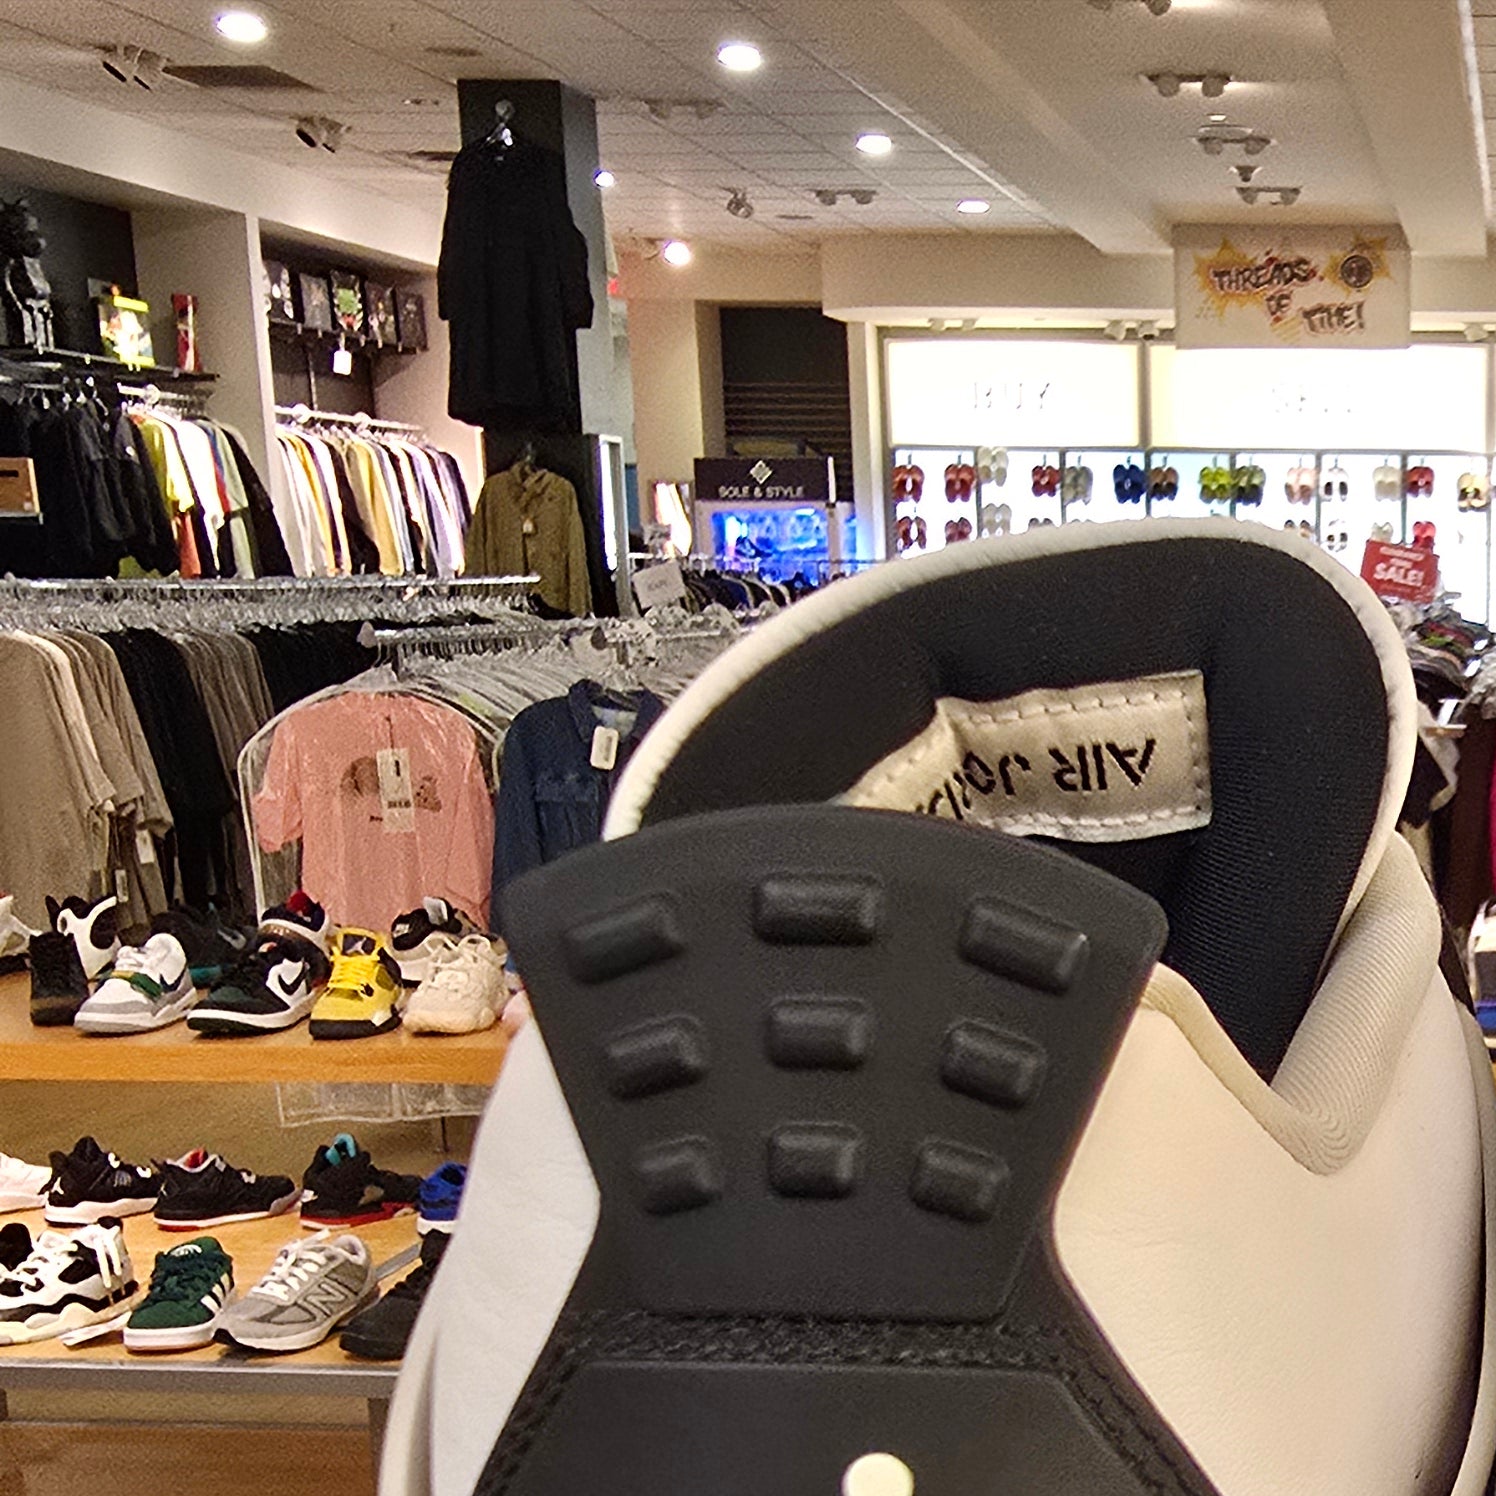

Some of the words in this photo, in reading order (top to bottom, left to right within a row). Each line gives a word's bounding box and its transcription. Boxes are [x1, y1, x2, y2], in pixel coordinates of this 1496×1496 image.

[1211, 256, 1312, 292] THREADS
[718, 485, 750, 498] SOLE
[753, 486, 763, 498] &
[765, 486, 805, 498] STYLE
[1047, 737, 1157, 792] AIR
